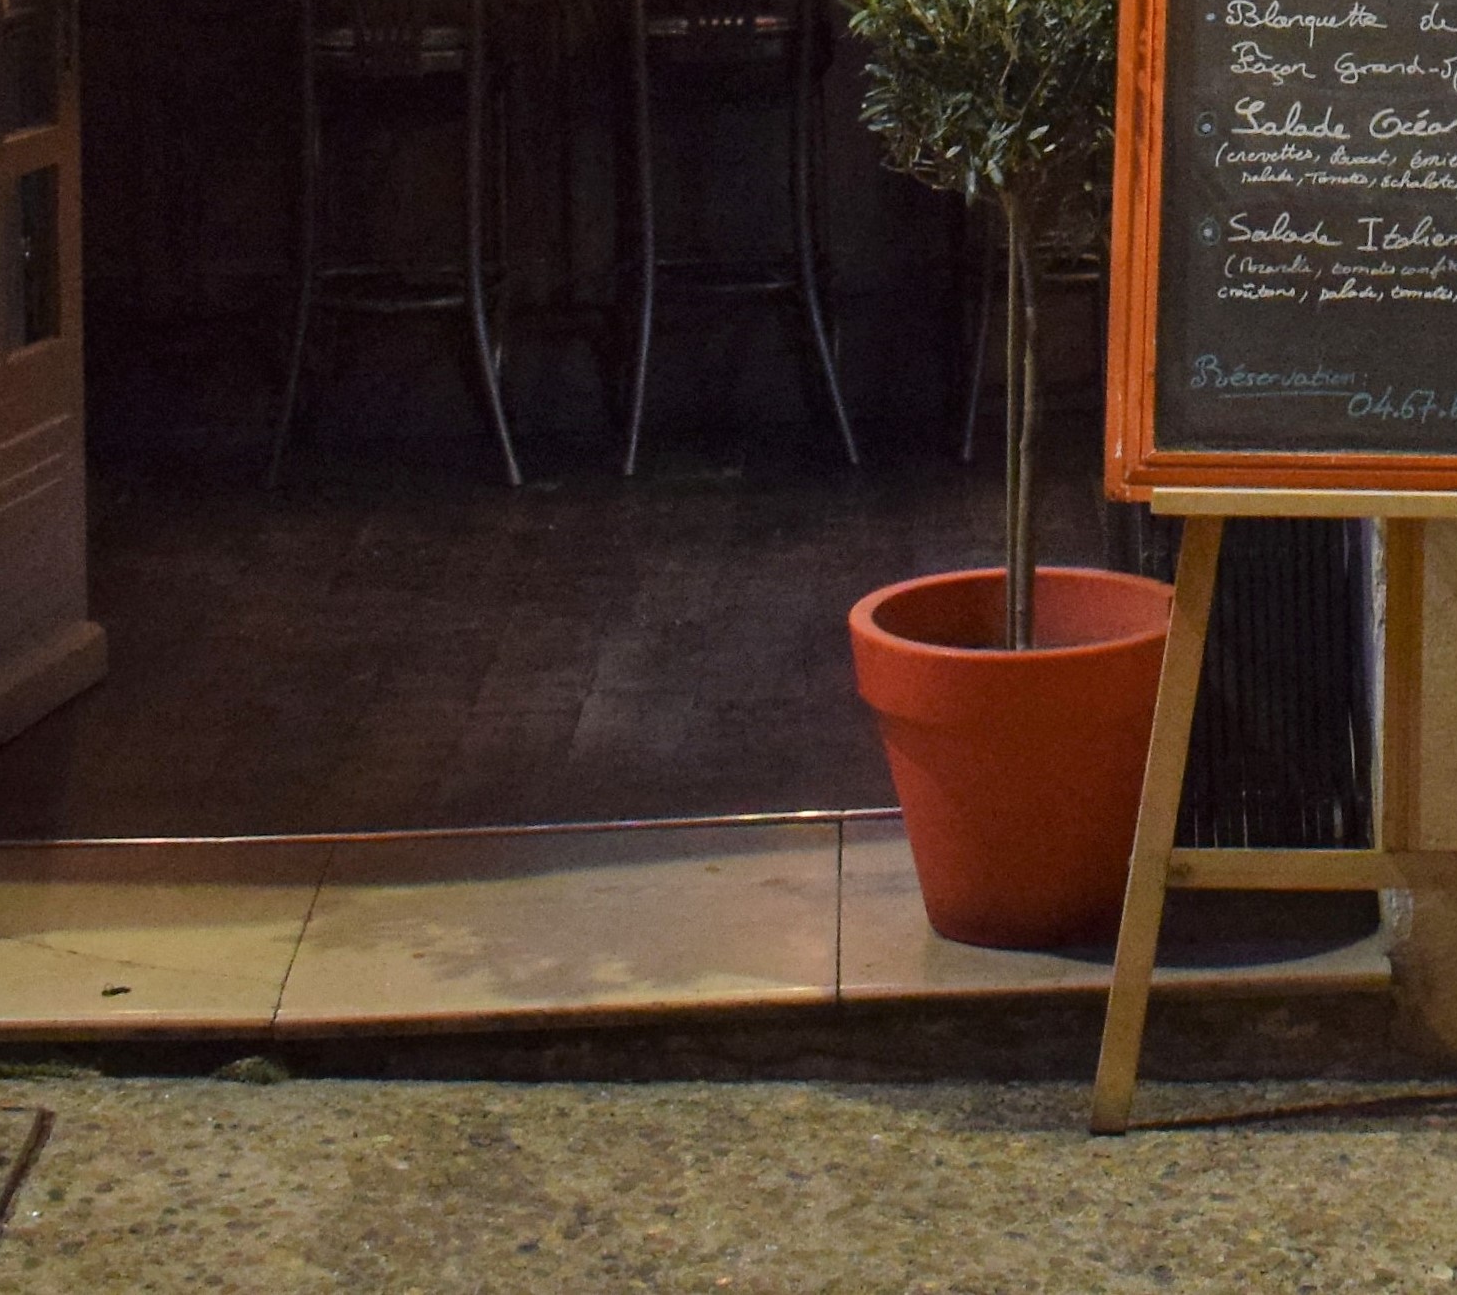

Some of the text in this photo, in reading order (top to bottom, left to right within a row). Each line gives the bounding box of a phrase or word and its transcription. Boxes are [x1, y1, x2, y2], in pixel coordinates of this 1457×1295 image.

[1226, 0, 1387, 48] Blanquette
[1230, 40, 1316, 86] Façon
[1231, 96, 1351, 139] Salade
[1228, 212, 1343, 247] Salade
